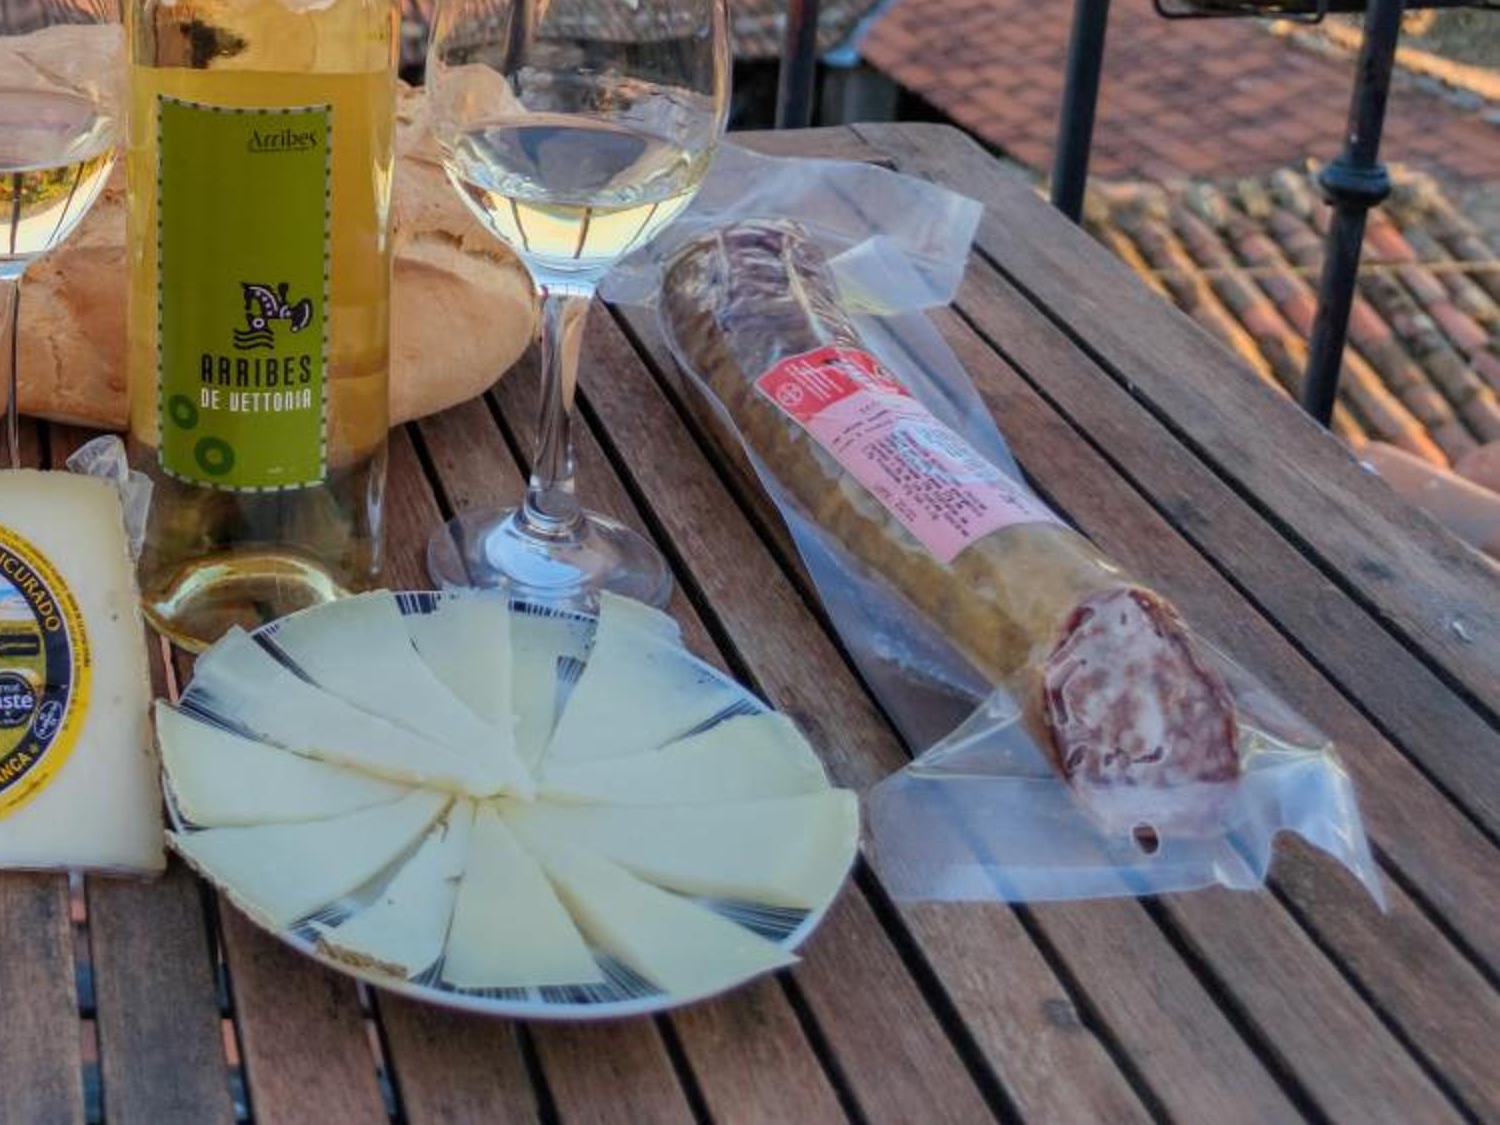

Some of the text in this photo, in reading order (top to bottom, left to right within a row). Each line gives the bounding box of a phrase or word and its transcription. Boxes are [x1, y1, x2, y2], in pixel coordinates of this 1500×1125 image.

[247, 127, 317, 150] Arribes
[201, 353, 311, 387] ARRIBES
[201, 387, 220, 410] DE
